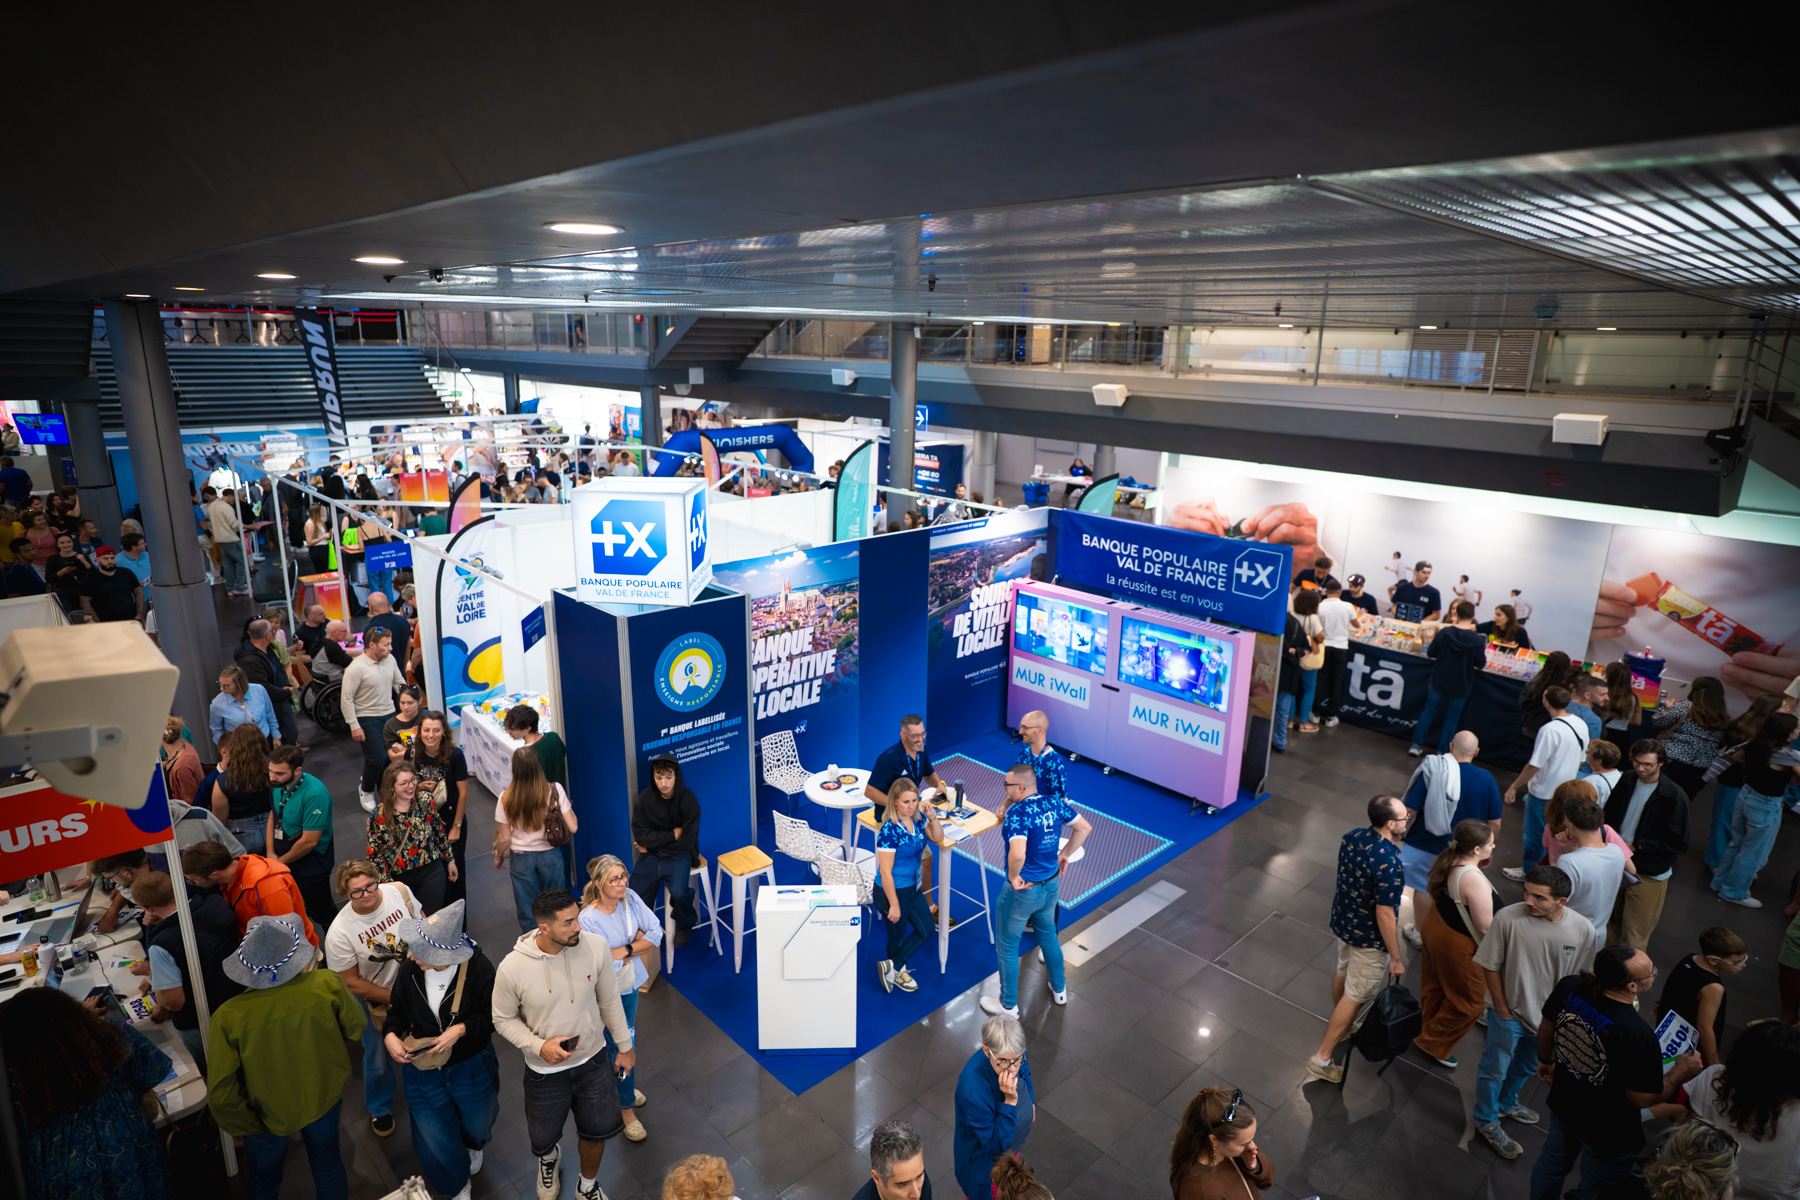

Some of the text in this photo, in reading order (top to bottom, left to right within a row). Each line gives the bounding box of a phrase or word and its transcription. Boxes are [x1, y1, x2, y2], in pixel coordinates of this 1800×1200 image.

[183, 444, 257, 458] KIPRUN
[713, 434, 775, 448] INISHERS
[1082, 533, 1139, 557] BANQUE
[1142, 546, 1228, 577] POPULAIRE
[580, 577, 683, 589] BANQUE POPULAIRE
[1116, 554, 1227, 591] VAL DE FRANCE
[595, 588, 671, 599] VAL DE FRANCE
[1106, 573, 1116, 585] la
[1117, 576, 1158, 596] réussite
[1160, 587, 1177, 600] est
[1180, 592, 1194, 604] en
[1197, 597, 1224, 612] vous
[456, 600, 486, 613] VAL DE
[456, 609, 486, 625] LOIRE
[952, 611, 972, 638] DE
[680, 637, 700, 647] LABEL
[956, 624, 1006, 659] LOCALE
[686, 664, 722, 707] RESPONSABLE
[1015, 666, 1045, 688] MUR
[1050, 677, 1087, 701] iWall
[756, 678, 823, 720] LOCALE
[642, 716, 743, 752] ENSEIGNE RESPONSABLE EN FRANCE
[669, 721, 693, 735] BANQUE
[694, 711, 726, 729] LABELLISÉE
[1132, 704, 1220, 746] MUR iWall
[688, 739, 709, 750] agissons
[707, 741, 725, 750] sociale
[357, 909, 404, 945] FARM RIO
